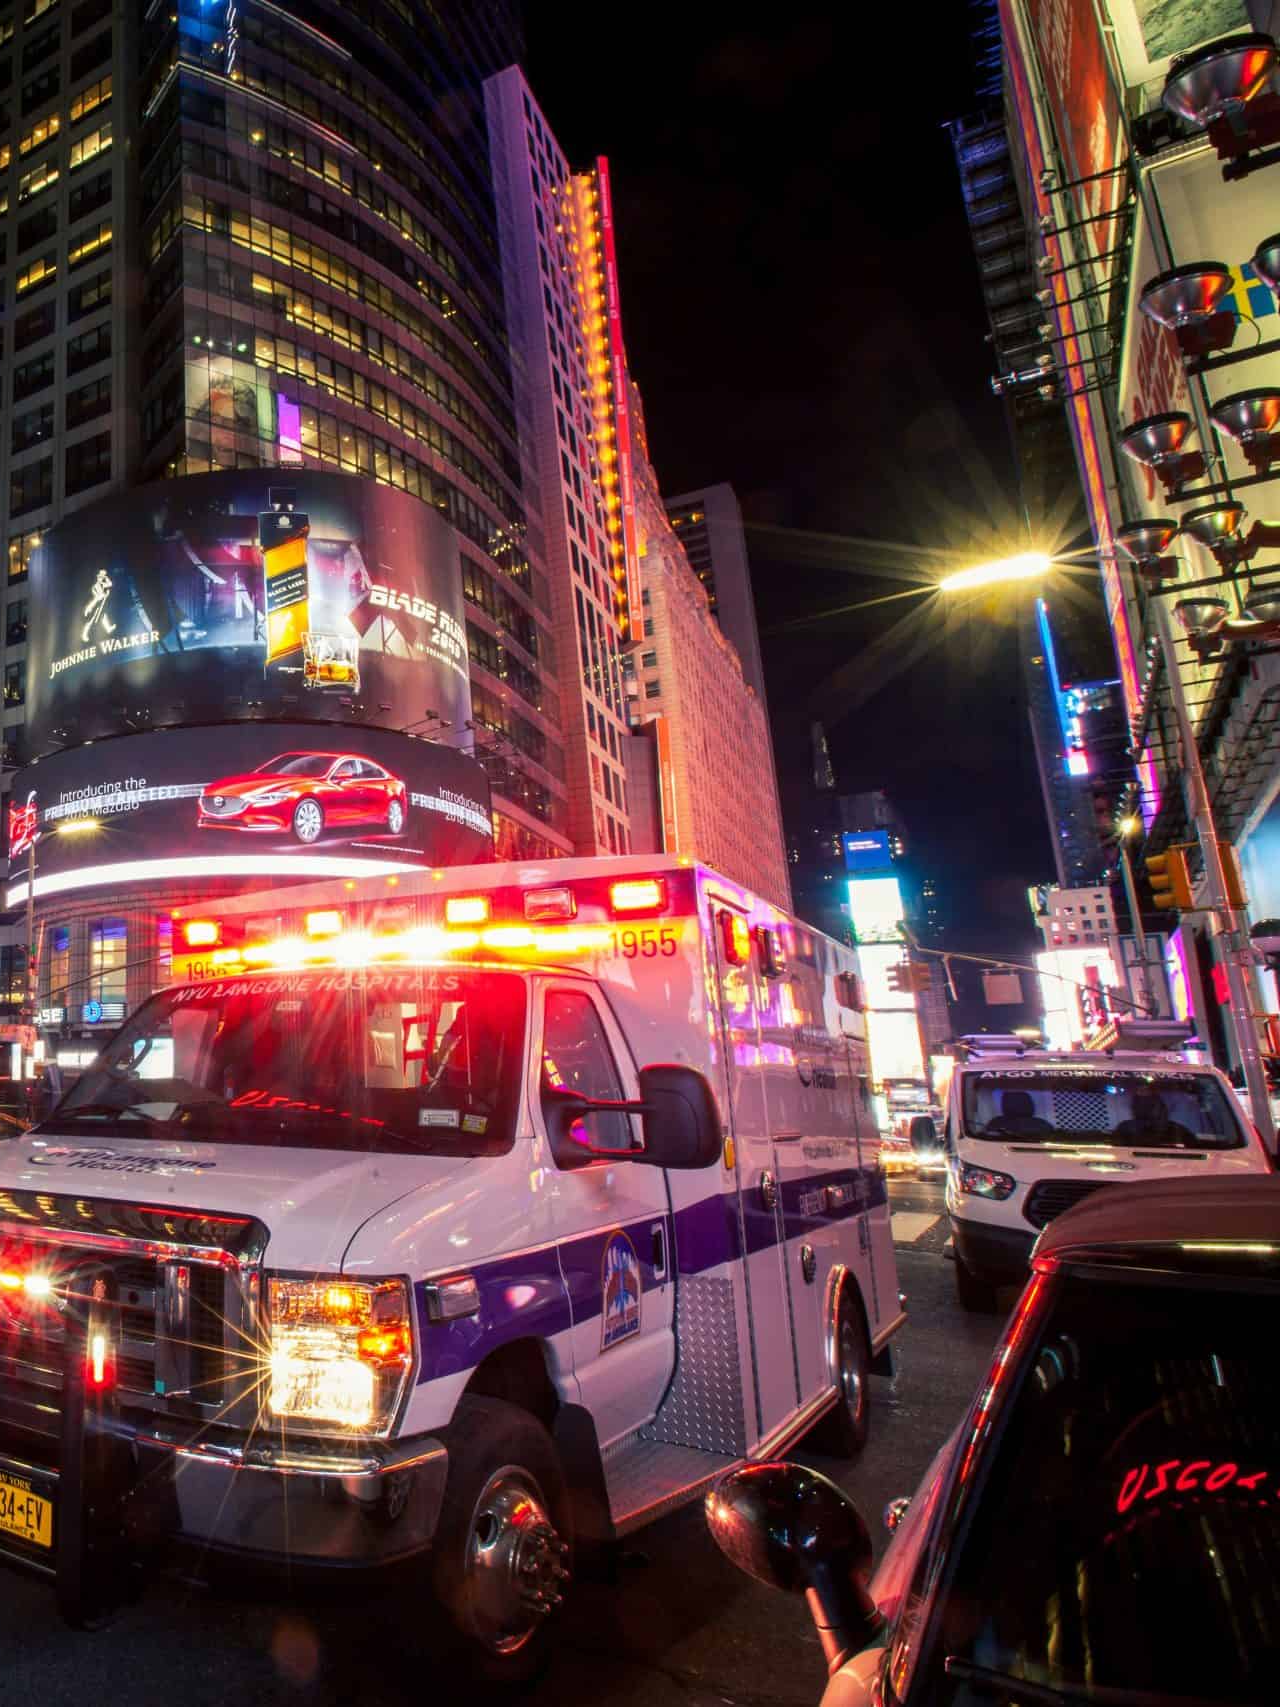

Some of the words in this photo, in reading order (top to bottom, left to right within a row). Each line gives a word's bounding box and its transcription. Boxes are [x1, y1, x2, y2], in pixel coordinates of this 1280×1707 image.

[369, 584, 437, 624] BLADE
[49, 646, 96, 679] JOHNNIE
[100, 630, 159, 654] WALKER
[60, 782, 122, 804] Introducing
[125, 777, 147, 790] the
[610, 928, 677, 959] 1955
[172, 988, 212, 1002] NYU
[213, 976, 313, 999] LANGONE
[313, 975, 460, 992] HOSPITALS
[980, 1070, 1036, 1079] AFGO
[1040, 1070, 1130, 1079] MECHANICAL
[1133, 1071, 1196, 1081] SERVICES
